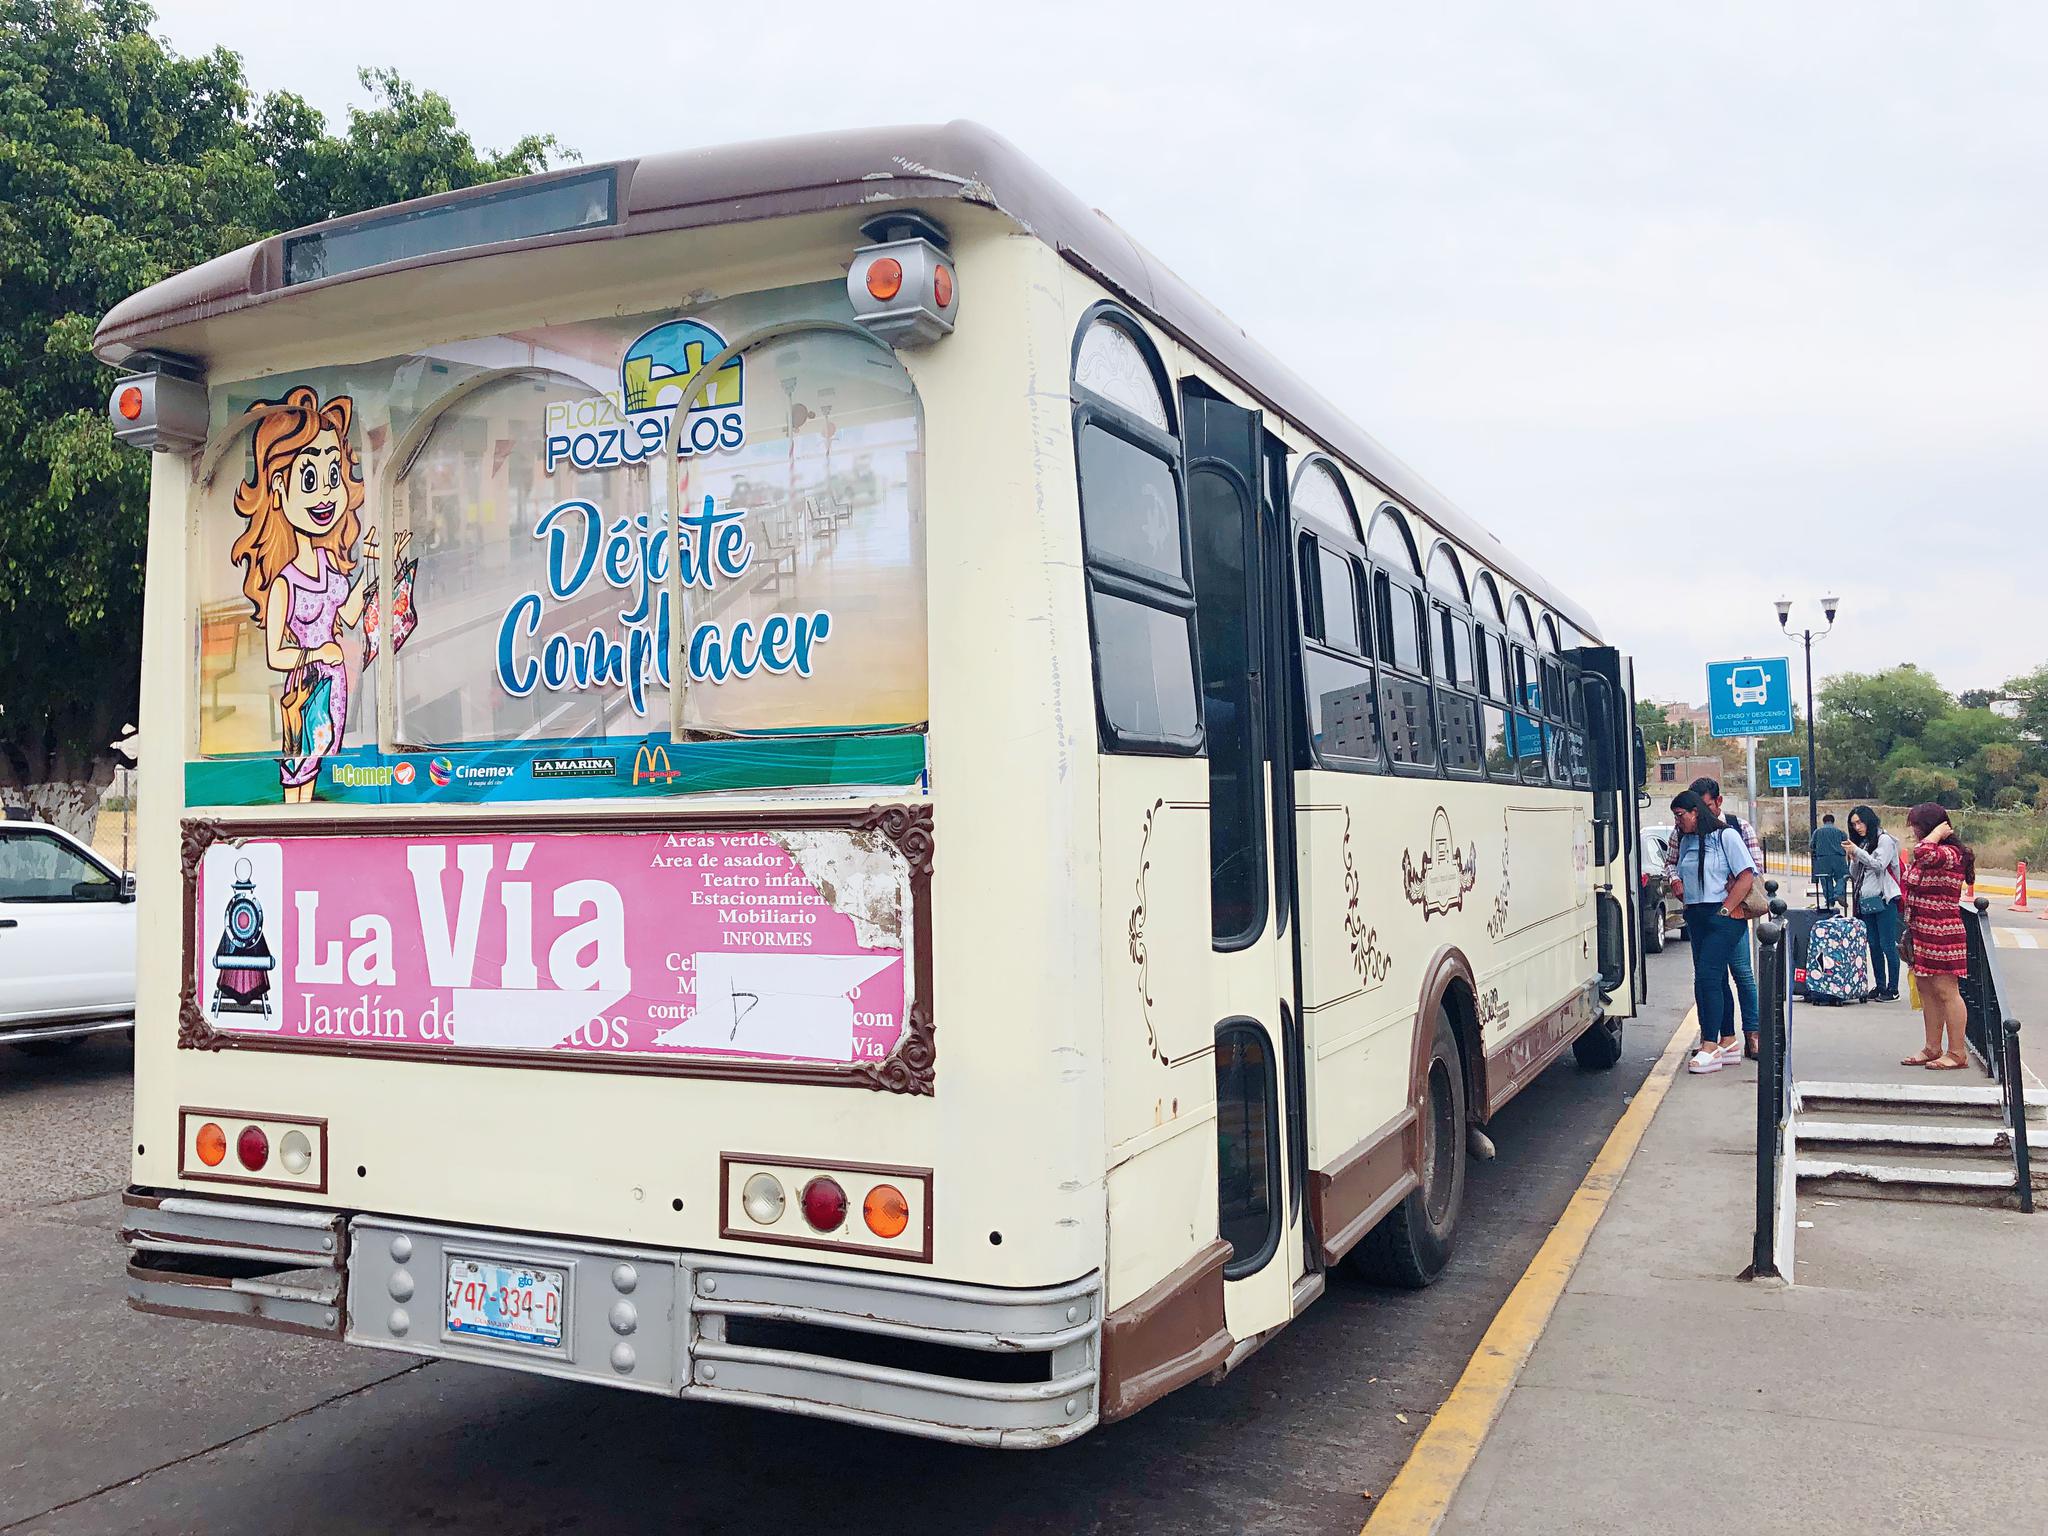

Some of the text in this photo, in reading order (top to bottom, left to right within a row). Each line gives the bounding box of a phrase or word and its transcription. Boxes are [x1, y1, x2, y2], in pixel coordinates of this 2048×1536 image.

[534, 495, 753, 625] Déjate
[498, 591, 831, 716] Complacer
[1751, 710, 1787, 718] DESCENSO
[1716, 724, 1786, 734] AUTOBUSES URBANOS
[455, 765, 514, 779] Cinemex
[534, 760, 613, 771] LA MARINA
[663, 832, 777, 848] Areas verdes
[650, 854, 692, 868] Area
[697, 853, 719, 868] de
[723, 852, 784, 868] asador
[701, 872, 760, 888] Teatro
[690, 890, 830, 907] Estacionamien
[295, 842, 631, 990] La Vía
[718, 908, 817, 924] Mobiliario
[722, 931, 812, 947] INFORMES
[297, 993, 408, 1039] Jardín
[418, 995, 456, 1040] de
[451, 1280, 558, 1324] 747-334-D
